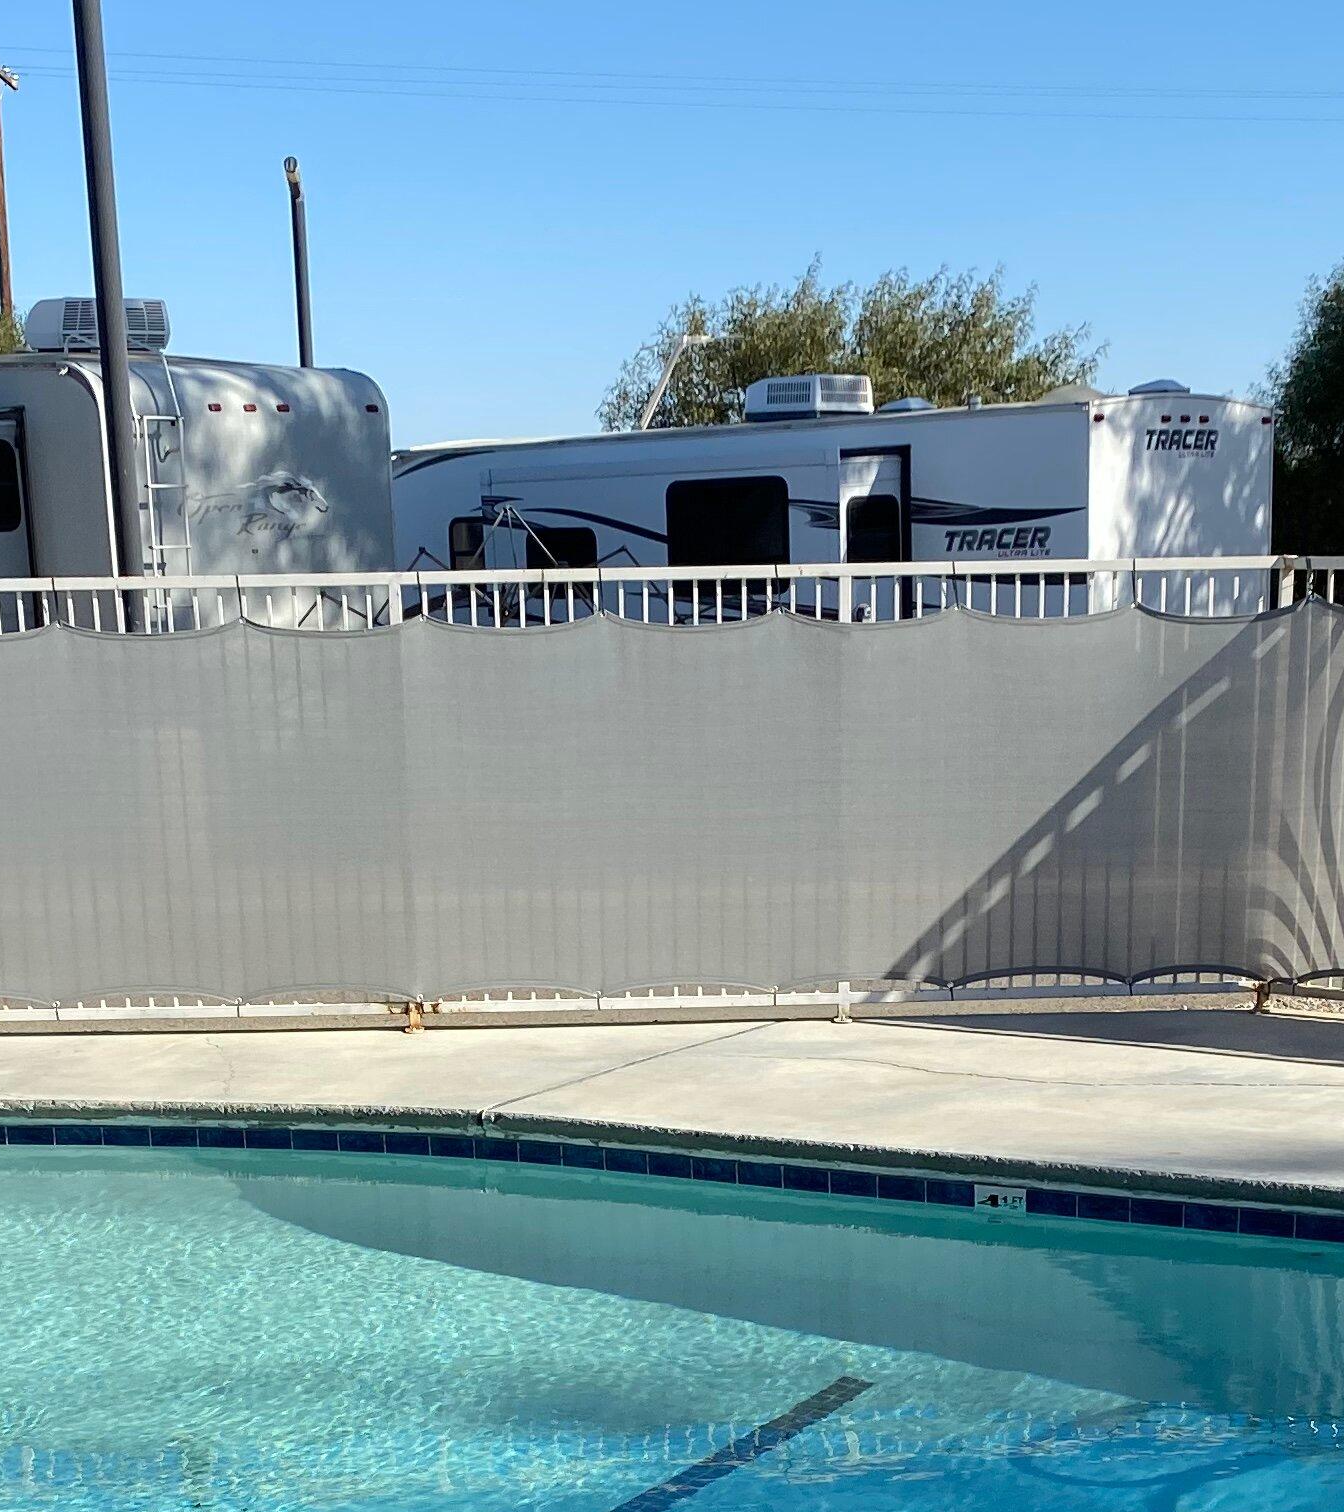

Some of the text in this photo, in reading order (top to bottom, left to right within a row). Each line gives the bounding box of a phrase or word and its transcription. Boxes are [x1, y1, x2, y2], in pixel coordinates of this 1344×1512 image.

[1145, 428, 1219, 451] TRACER
[236, 512, 307, 540] Range
[944, 526, 1052, 552] TRACER
[997, 548, 1051, 558] ULTRA LITE
